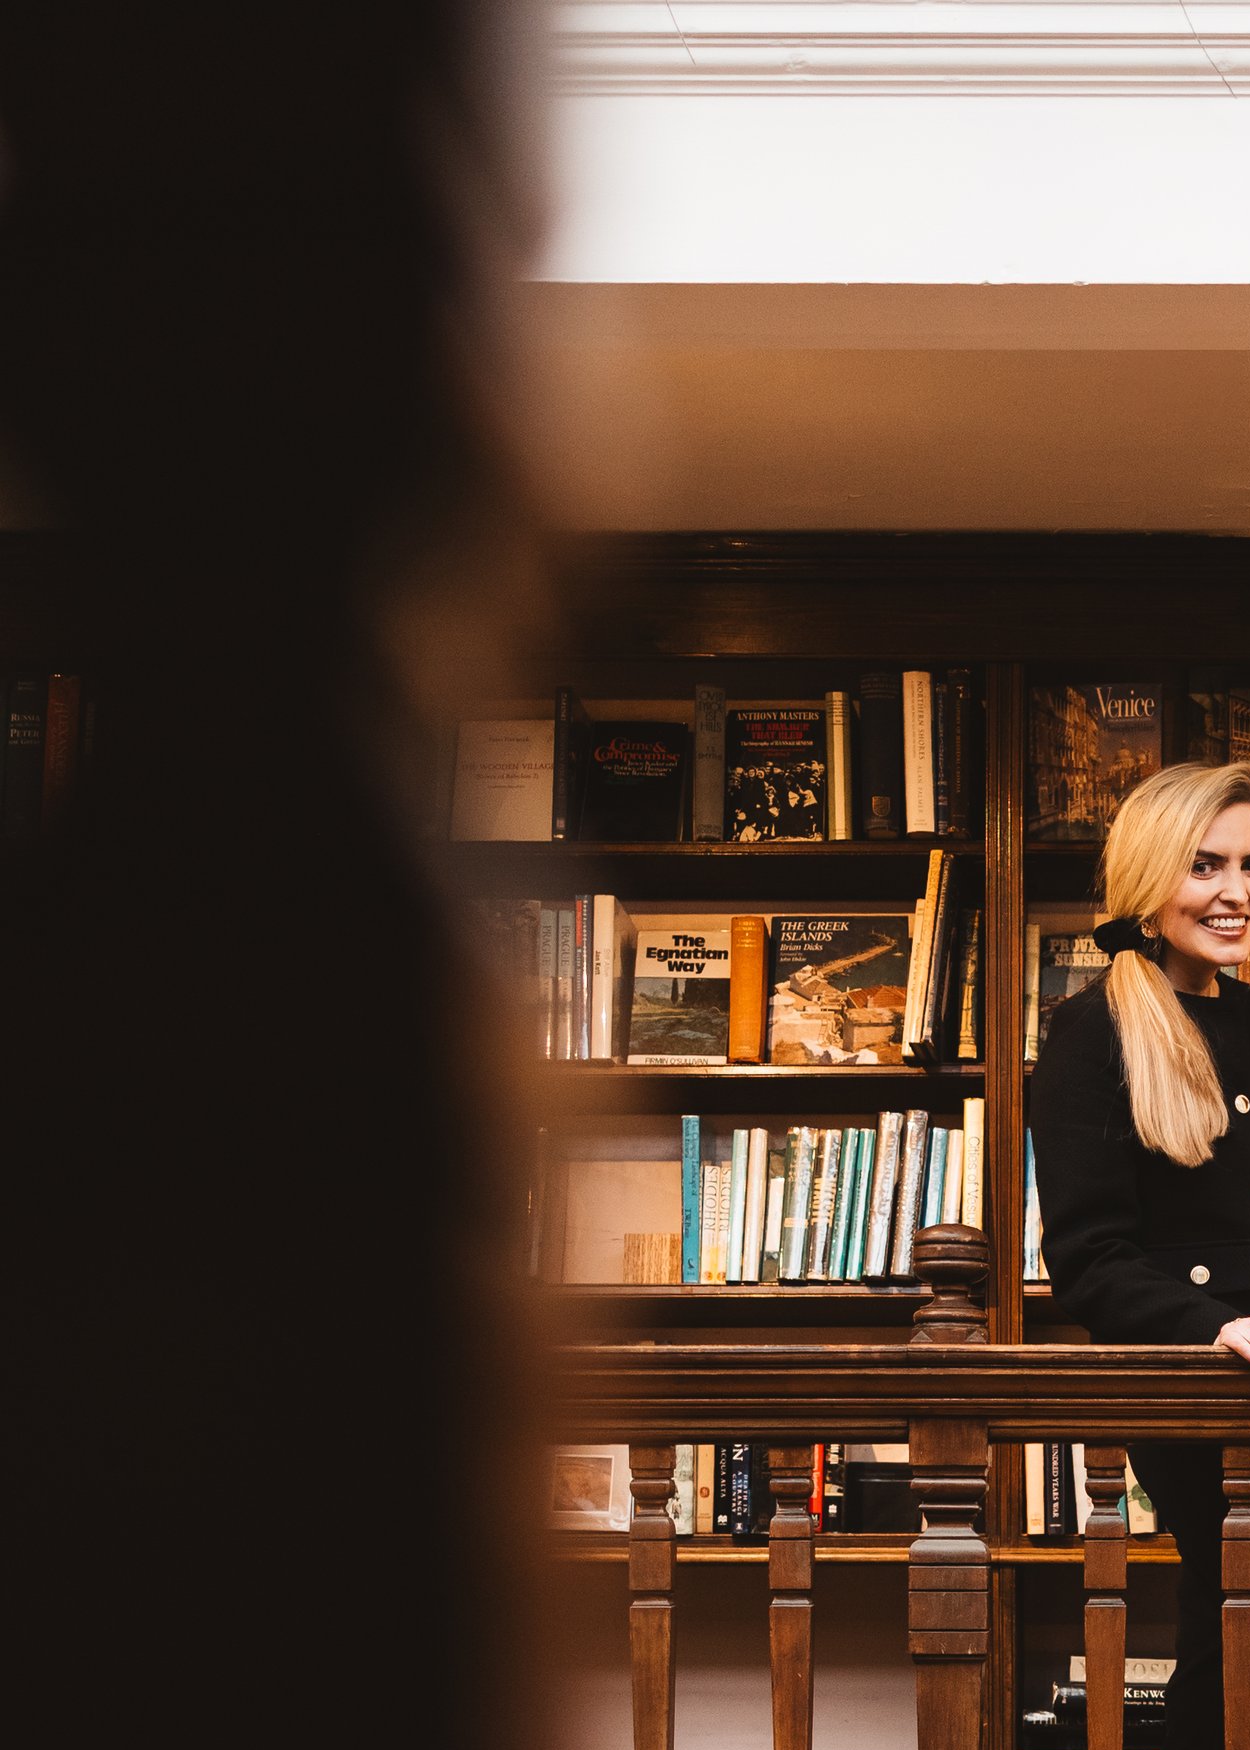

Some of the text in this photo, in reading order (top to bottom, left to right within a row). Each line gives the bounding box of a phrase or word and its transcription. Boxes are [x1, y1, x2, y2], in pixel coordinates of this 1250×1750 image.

[1096, 687, 1155, 720] Venice
[737, 712, 819, 720] ANTHONY MASTERS
[780, 922, 849, 931] THE GREEK
[672, 935, 705, 947] The
[781, 932, 833, 941] ISLANDS
[646, 948, 728, 964] Egnatian
[667, 961, 706, 974] Way
[704, 1167, 718, 1232] RHODES
